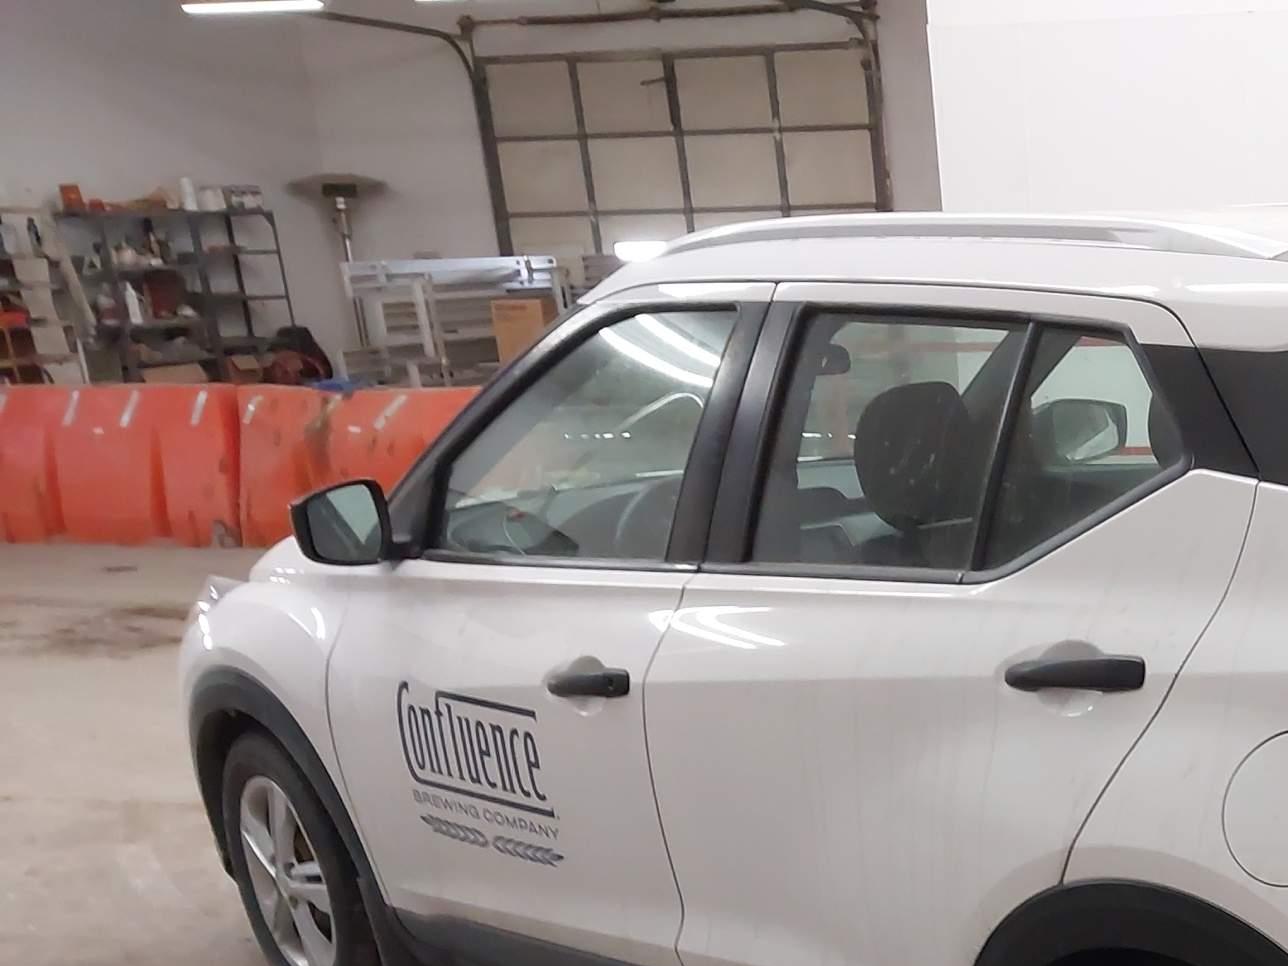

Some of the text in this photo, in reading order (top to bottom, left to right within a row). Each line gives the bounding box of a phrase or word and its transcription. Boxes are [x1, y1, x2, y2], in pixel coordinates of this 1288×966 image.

[396, 680, 556, 818] Confluence
[412, 788, 561, 840] BREWING COMPANY
